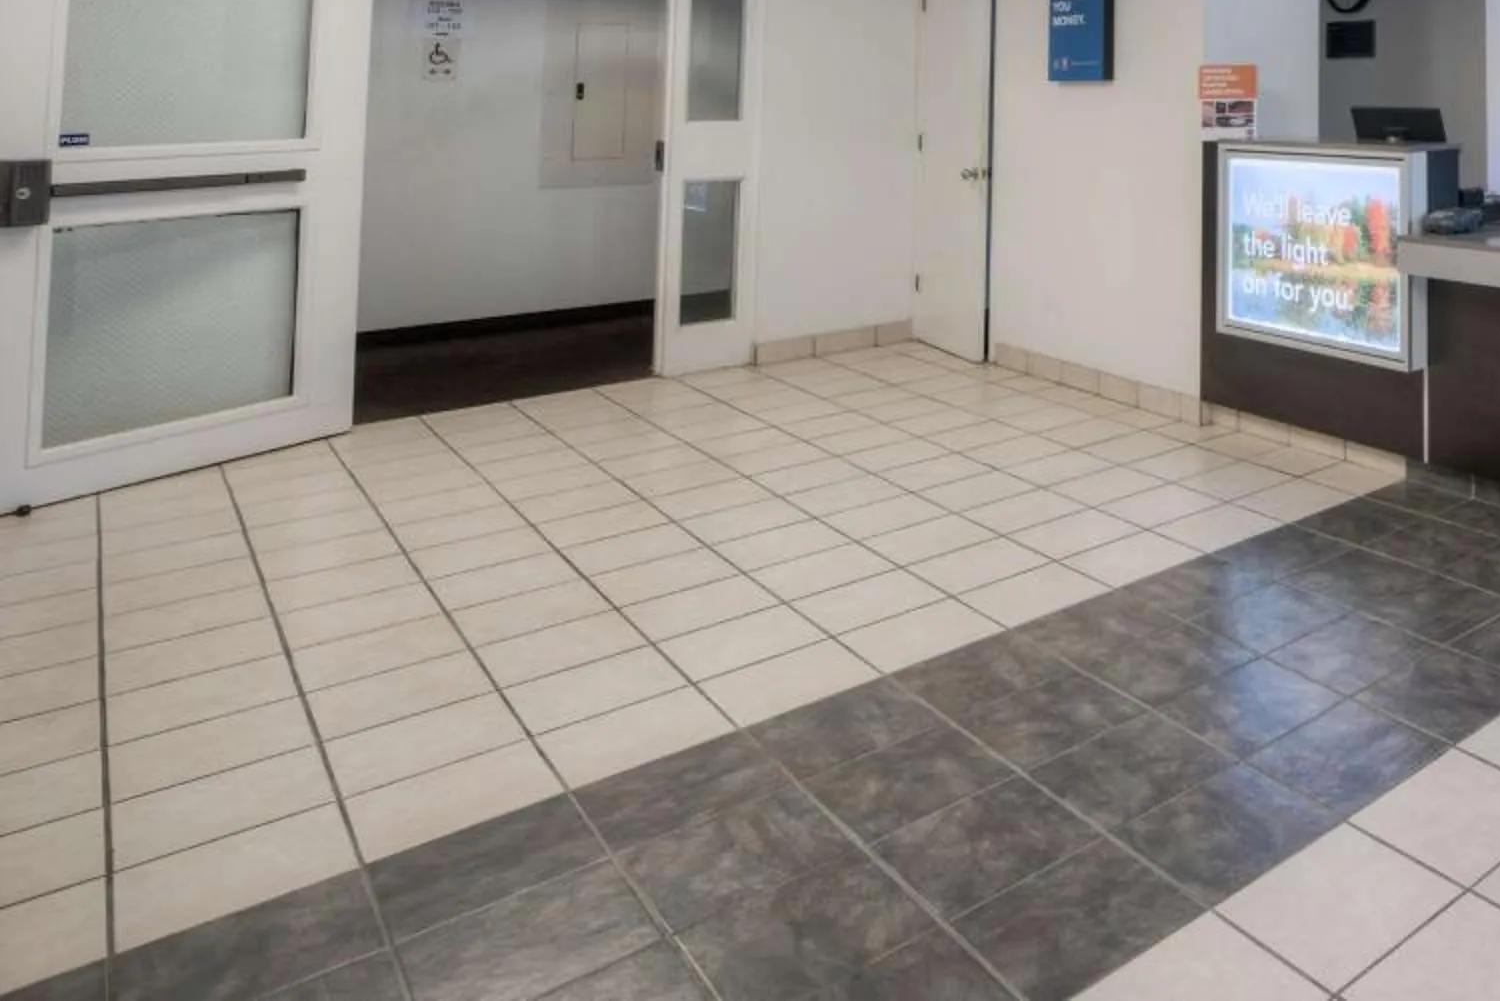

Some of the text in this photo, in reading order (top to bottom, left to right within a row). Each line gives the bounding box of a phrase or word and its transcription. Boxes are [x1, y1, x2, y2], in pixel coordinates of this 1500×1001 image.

[1053, 1, 1072, 12] YOU
[1299, 197, 1351, 226] leave
[1244, 231, 1329, 271] the light
[1243, 276, 1267, 296] on
[1275, 272, 1304, 303] for
